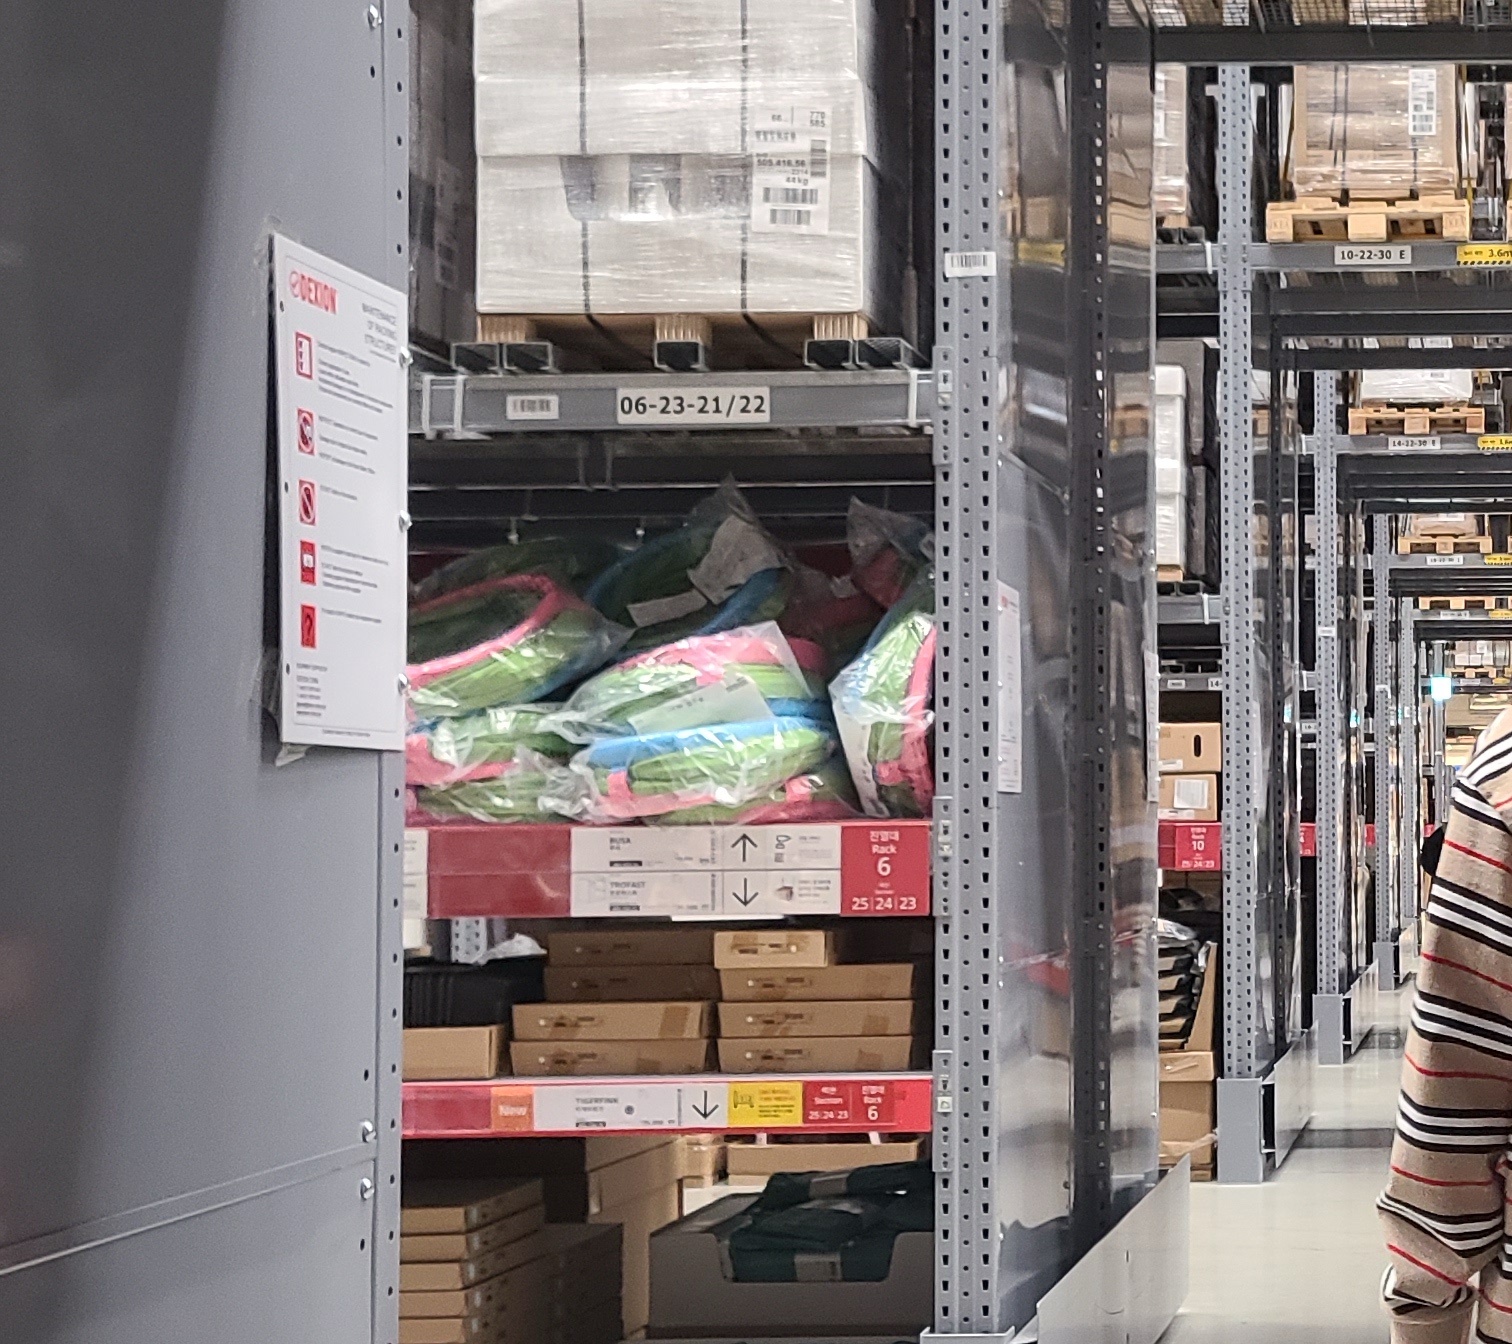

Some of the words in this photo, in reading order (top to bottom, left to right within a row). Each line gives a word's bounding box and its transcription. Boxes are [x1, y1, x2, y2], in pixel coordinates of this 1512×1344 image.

[1340, 249, 1392, 260] 10-22-30
[1399, 250, 1406, 260] E
[301, 273, 337, 315] DEXION
[619, 394, 767, 417] 06-23-21/22
[872, 843, 897, 855] Rack
[1191, 840, 1205, 851] 10
[876, 856, 892, 877] 6
[851, 897, 869, 911] 25
[875, 897, 893, 910] 24
[899, 896, 917, 910] 23
[867, 1105, 879, 1121] 6
